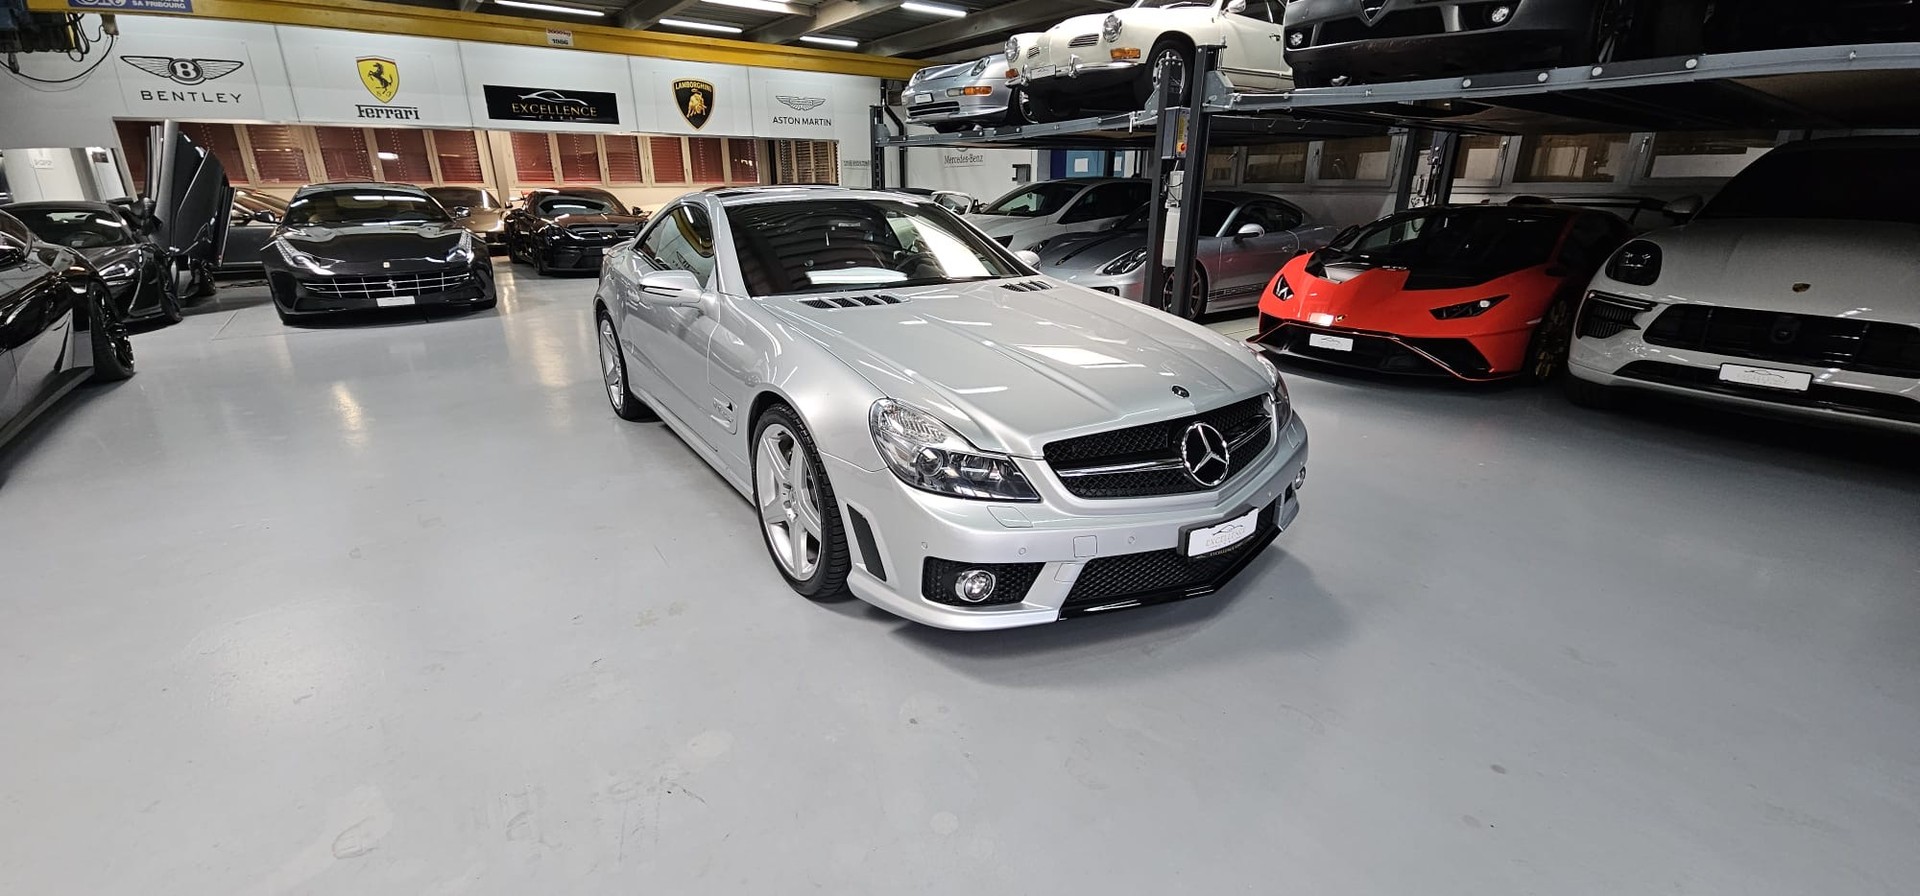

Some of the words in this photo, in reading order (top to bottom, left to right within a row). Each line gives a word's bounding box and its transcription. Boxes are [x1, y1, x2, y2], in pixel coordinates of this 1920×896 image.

[145, 1, 186, 9] FRIBOURG
[140, 90, 242, 104] BENTLEY
[355, 104, 420, 120] Ferrari
[511, 102, 598, 117] EXCELLENCE
[772, 116, 801, 125] ASTON
[801, 118, 832, 126] MARTIN
[943, 153, 984, 165] Mercedes-Benz
